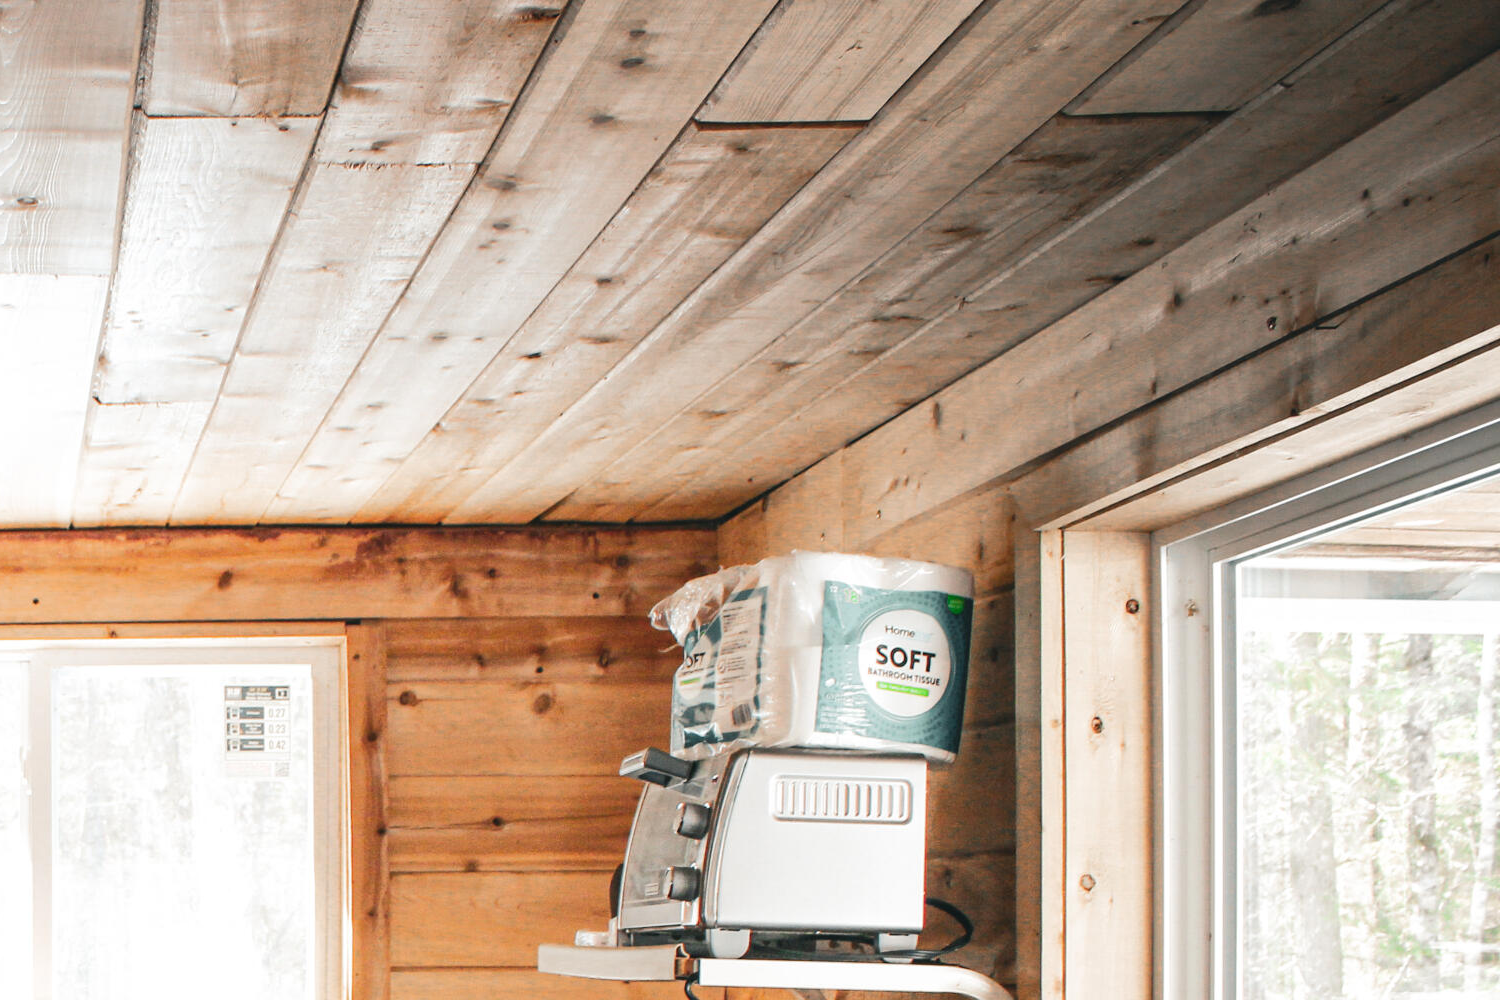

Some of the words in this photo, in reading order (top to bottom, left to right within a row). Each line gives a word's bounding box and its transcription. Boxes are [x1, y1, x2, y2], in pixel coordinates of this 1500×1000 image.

[884, 625, 916, 638] Home
[876, 644, 937, 673] SOFT
[867, 667, 914, 682] BATHROOM
[915, 675, 941, 687] TISSUE
